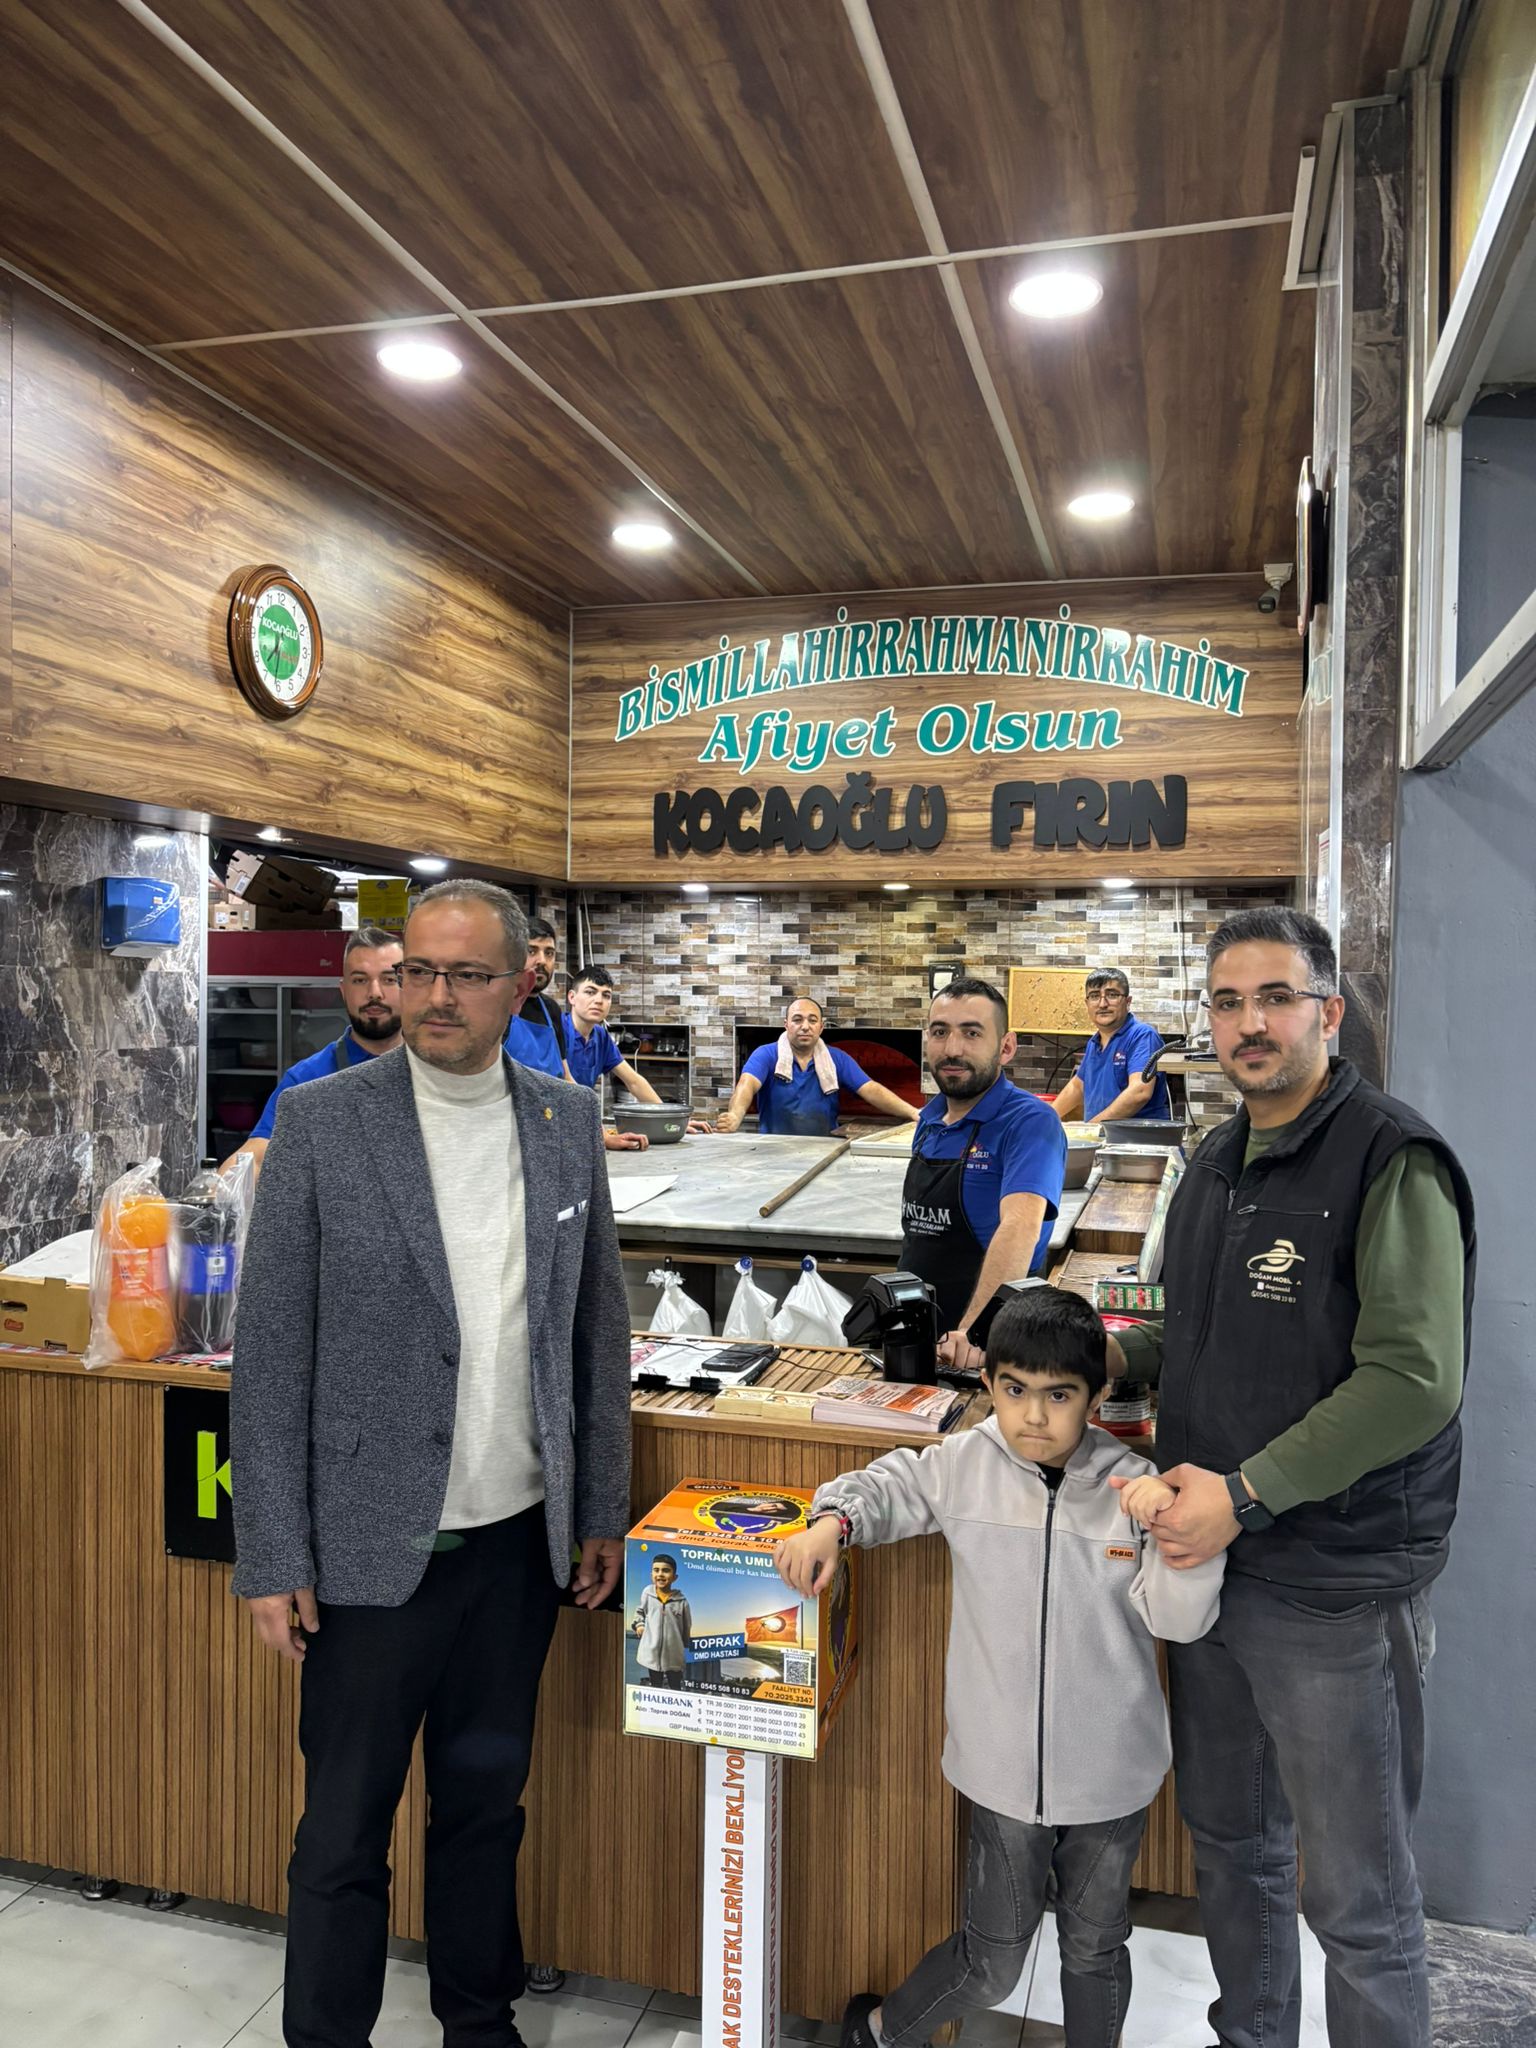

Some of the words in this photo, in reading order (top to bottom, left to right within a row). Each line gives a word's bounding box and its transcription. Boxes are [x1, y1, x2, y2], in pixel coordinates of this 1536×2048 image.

[277, 593, 286, 606] 12
[614, 604, 1251, 743] BİSMİLLAHİRRAHMANİRRAHİM
[698, 704, 897, 774] Afiyet
[916, 701, 1123, 757] Olsun
[653, 772, 948, 856] KOCAOĞLU
[992, 774, 1188, 850] FIRIN
[704, 1530, 733, 1539] 0545
[745, 1556, 773, 1568] UMU
[735, 1567, 745, 1575] bir
[747, 1569, 759, 1577] kas
[692, 1636, 741, 1650] TOPRAK
[694, 1652, 709, 1660] DMD
[711, 1649, 740, 1658] HASTASI
[700, 1682, 717, 1691] 0545
[718, 1685, 731, 1693] 508
[741, 1687, 750, 1695] 83
[771, 1684, 801, 1693] FAALİYET
[643, 1694, 693, 1708] HALKBANK
[670, 1709, 691, 1718] DOĞAN
[738, 1714, 752, 1722] 2001
[738, 1723, 752, 1731] 2001
[721, 1848, 744, 2018] DESTEKLERİNİZİ
